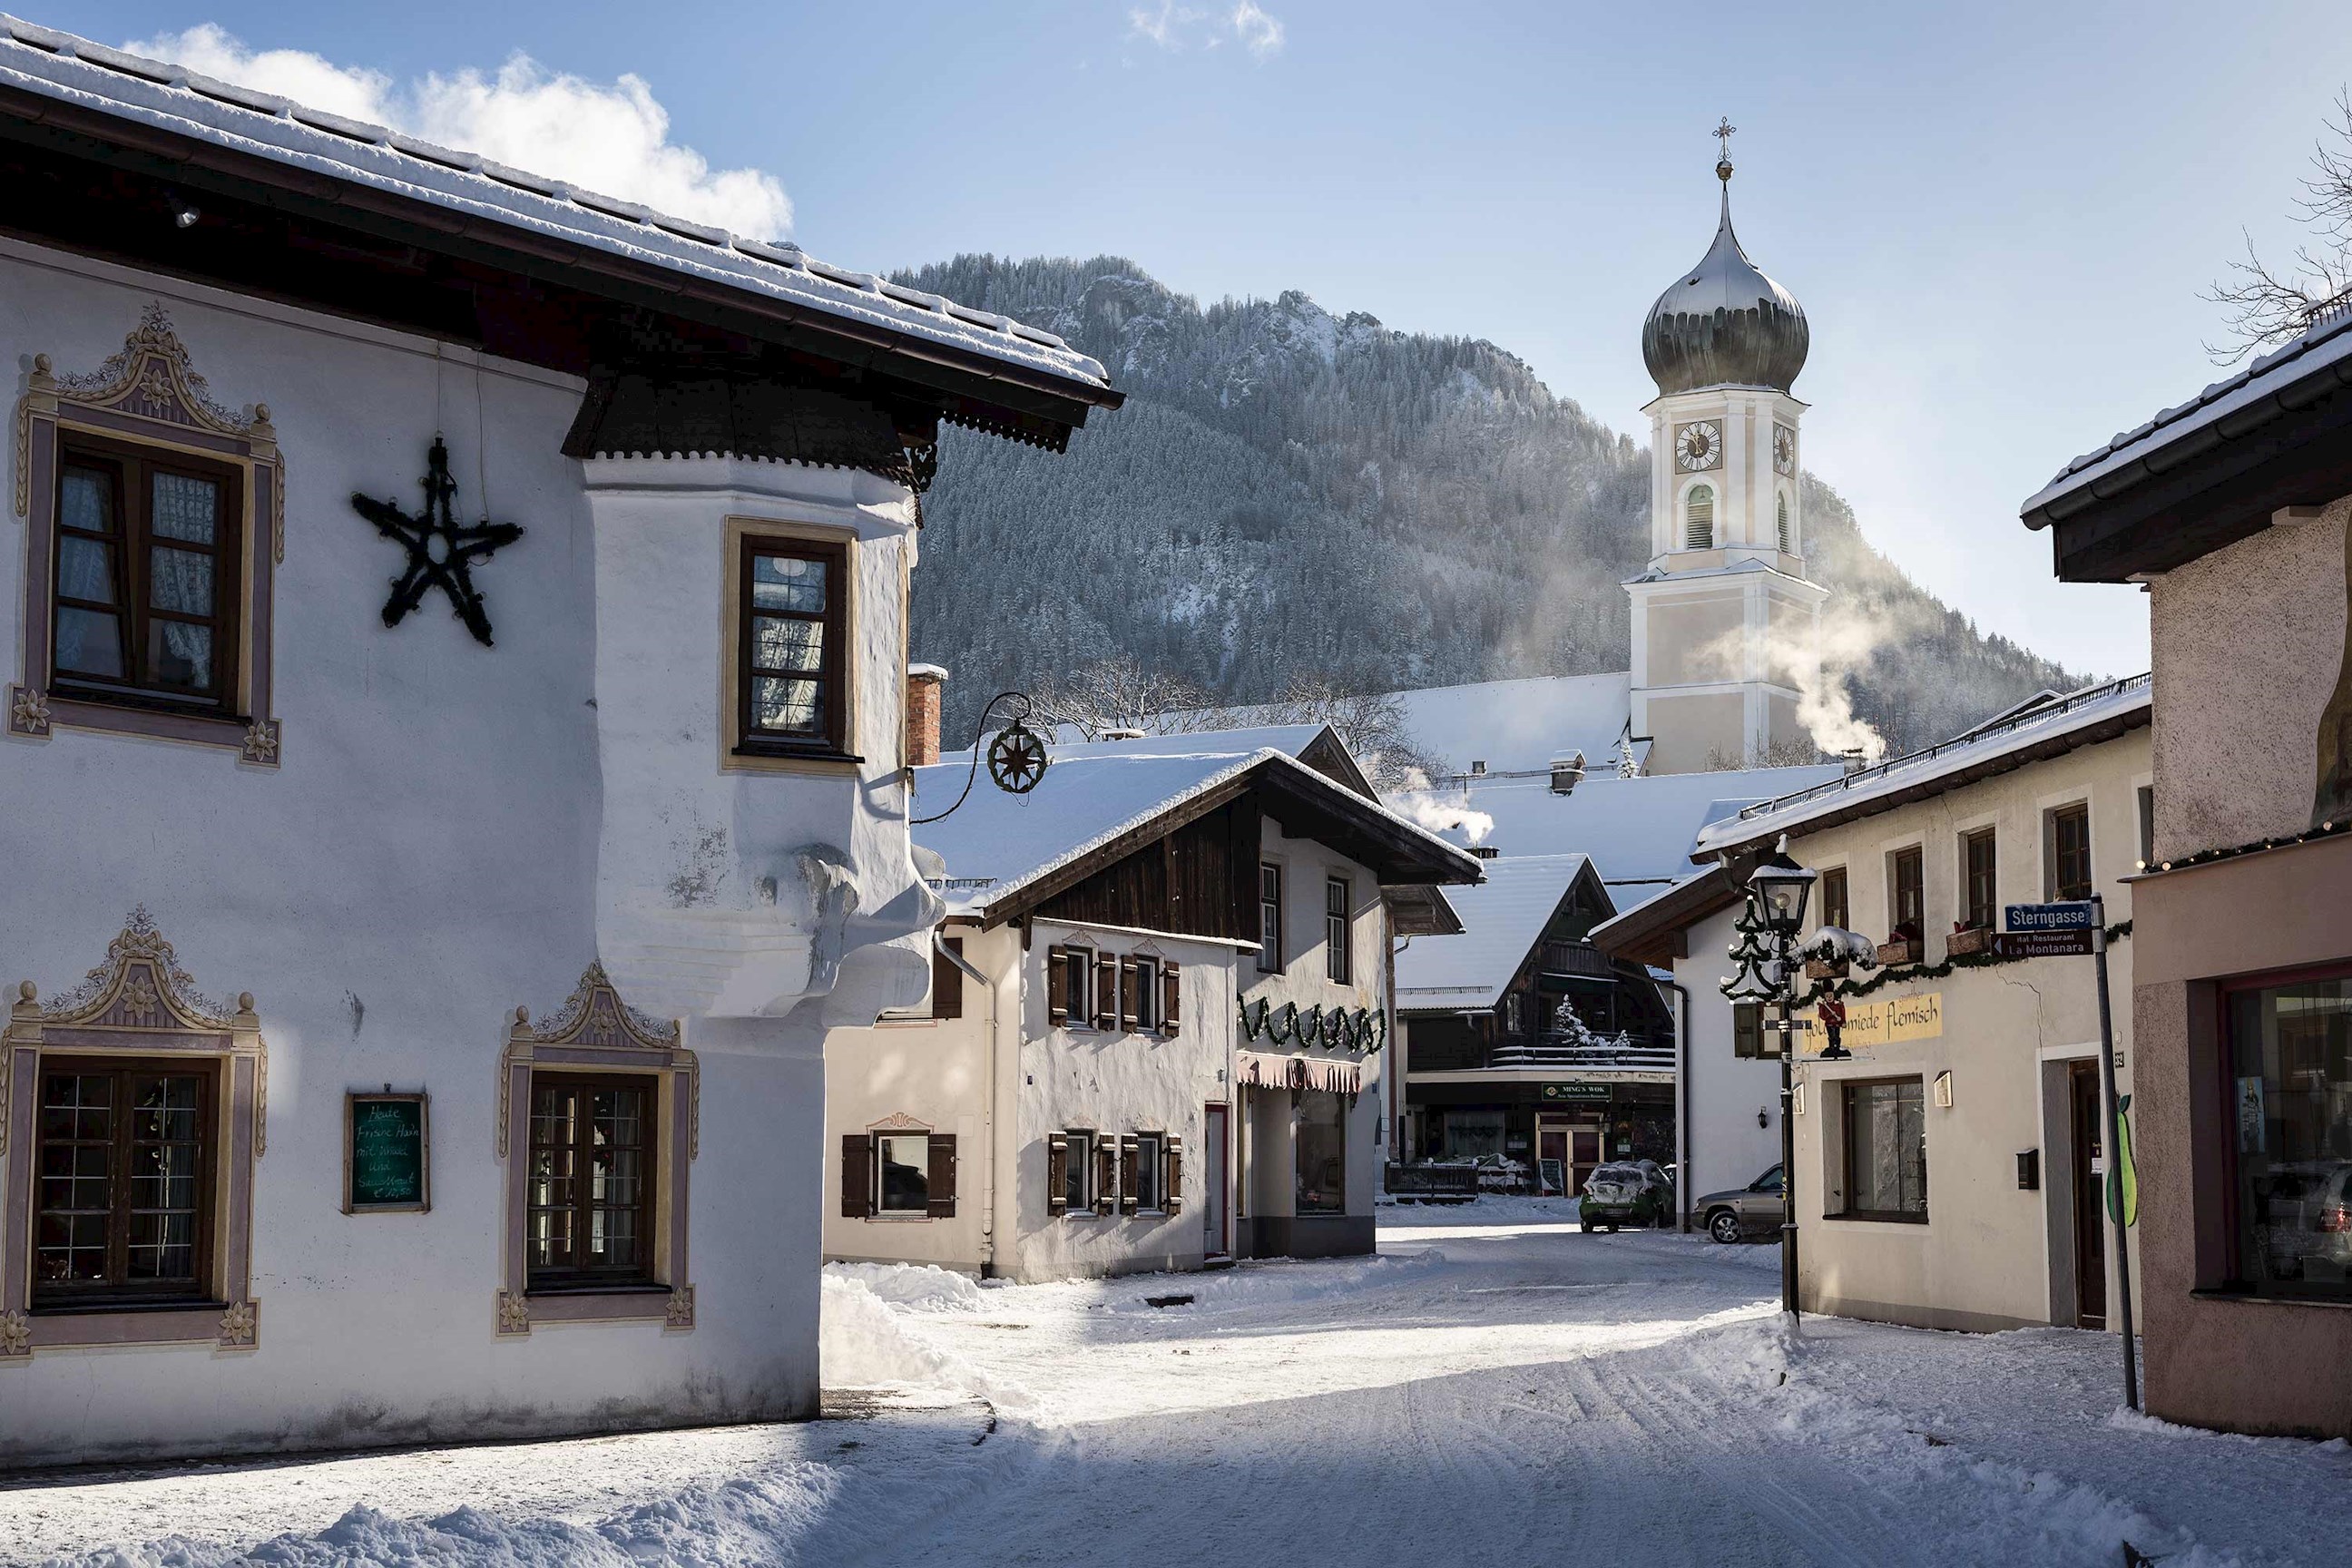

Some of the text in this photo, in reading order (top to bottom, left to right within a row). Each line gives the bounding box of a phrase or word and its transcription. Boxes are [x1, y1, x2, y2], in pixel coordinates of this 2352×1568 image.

[2012, 910, 2085, 927] Sterngasse
[2033, 934, 2075, 943] Restaurant
[2008, 944, 2084, 955] La Montanara
[1886, 996, 1938, 1041] flemisch
[369, 1104, 401, 1120] Heute
[356, 1144, 376, 1158] mit
